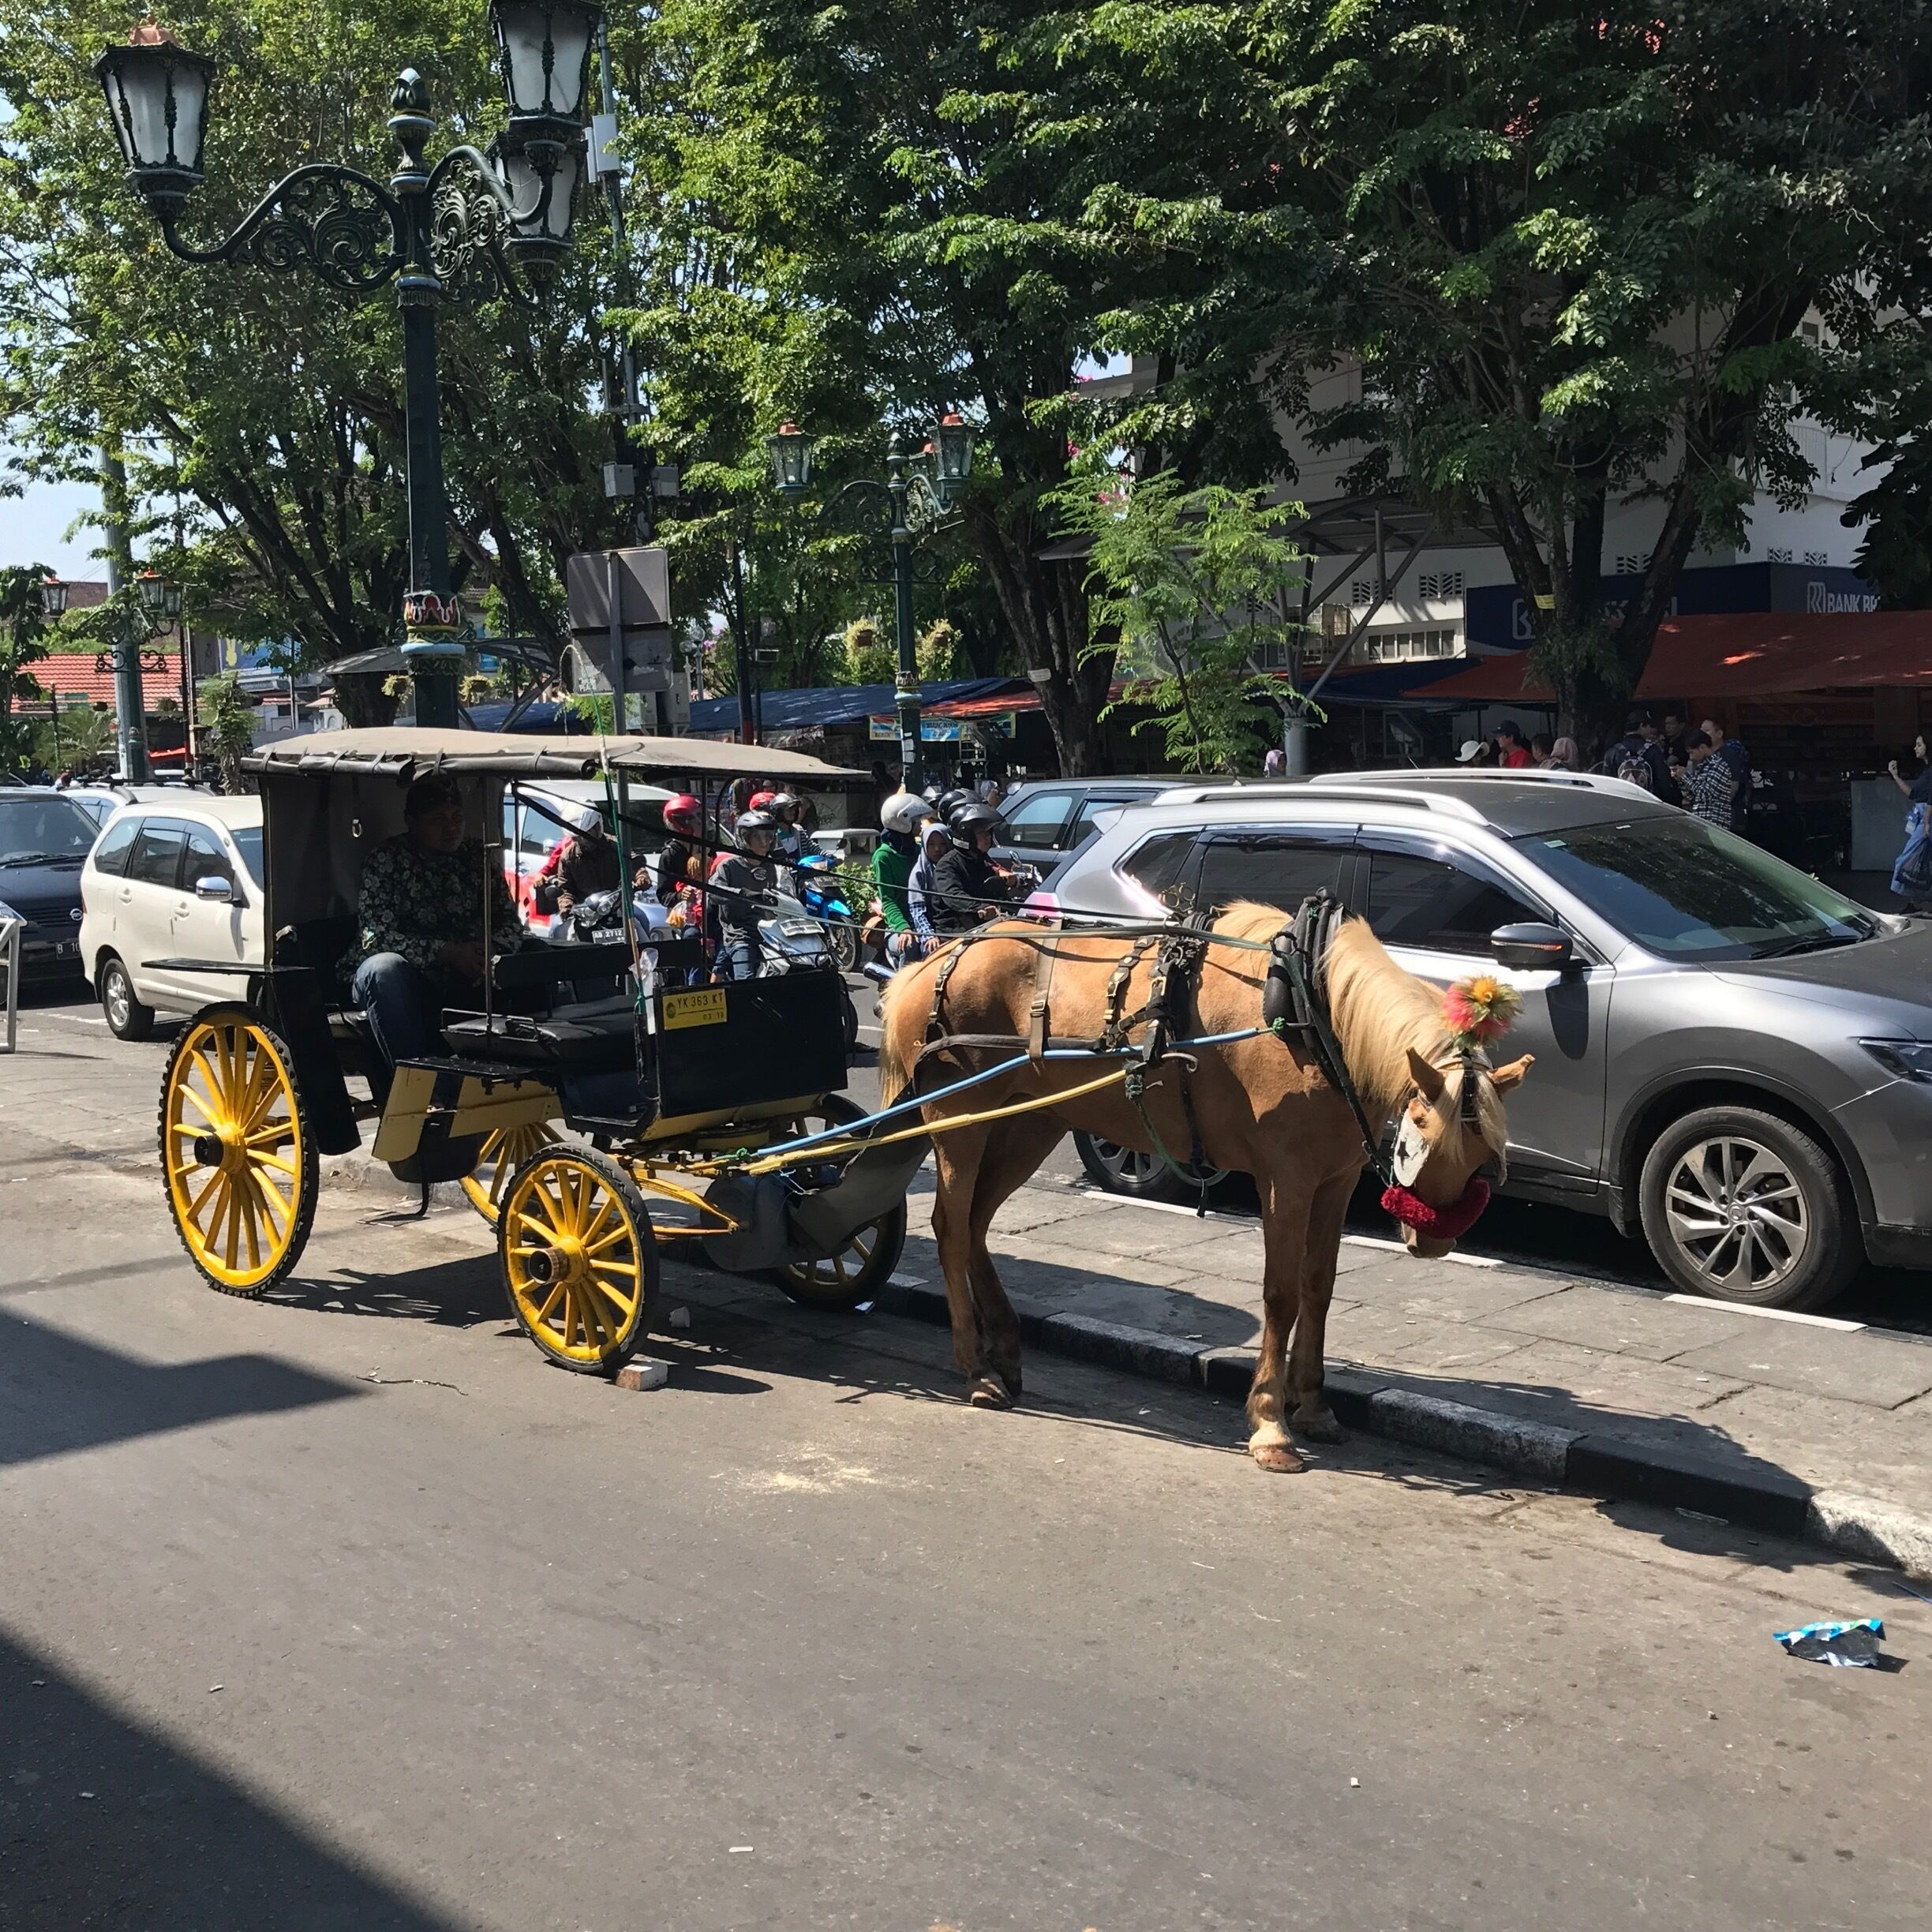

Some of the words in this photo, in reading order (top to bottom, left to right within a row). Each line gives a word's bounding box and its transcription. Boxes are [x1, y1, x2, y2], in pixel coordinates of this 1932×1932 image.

[1827, 593, 1861, 613] BANK
[1863, 594, 1881, 613] BR
[677, 997, 688, 1009] YK
[691, 994, 709, 1007] 363
[712, 992, 723, 1004] KT
